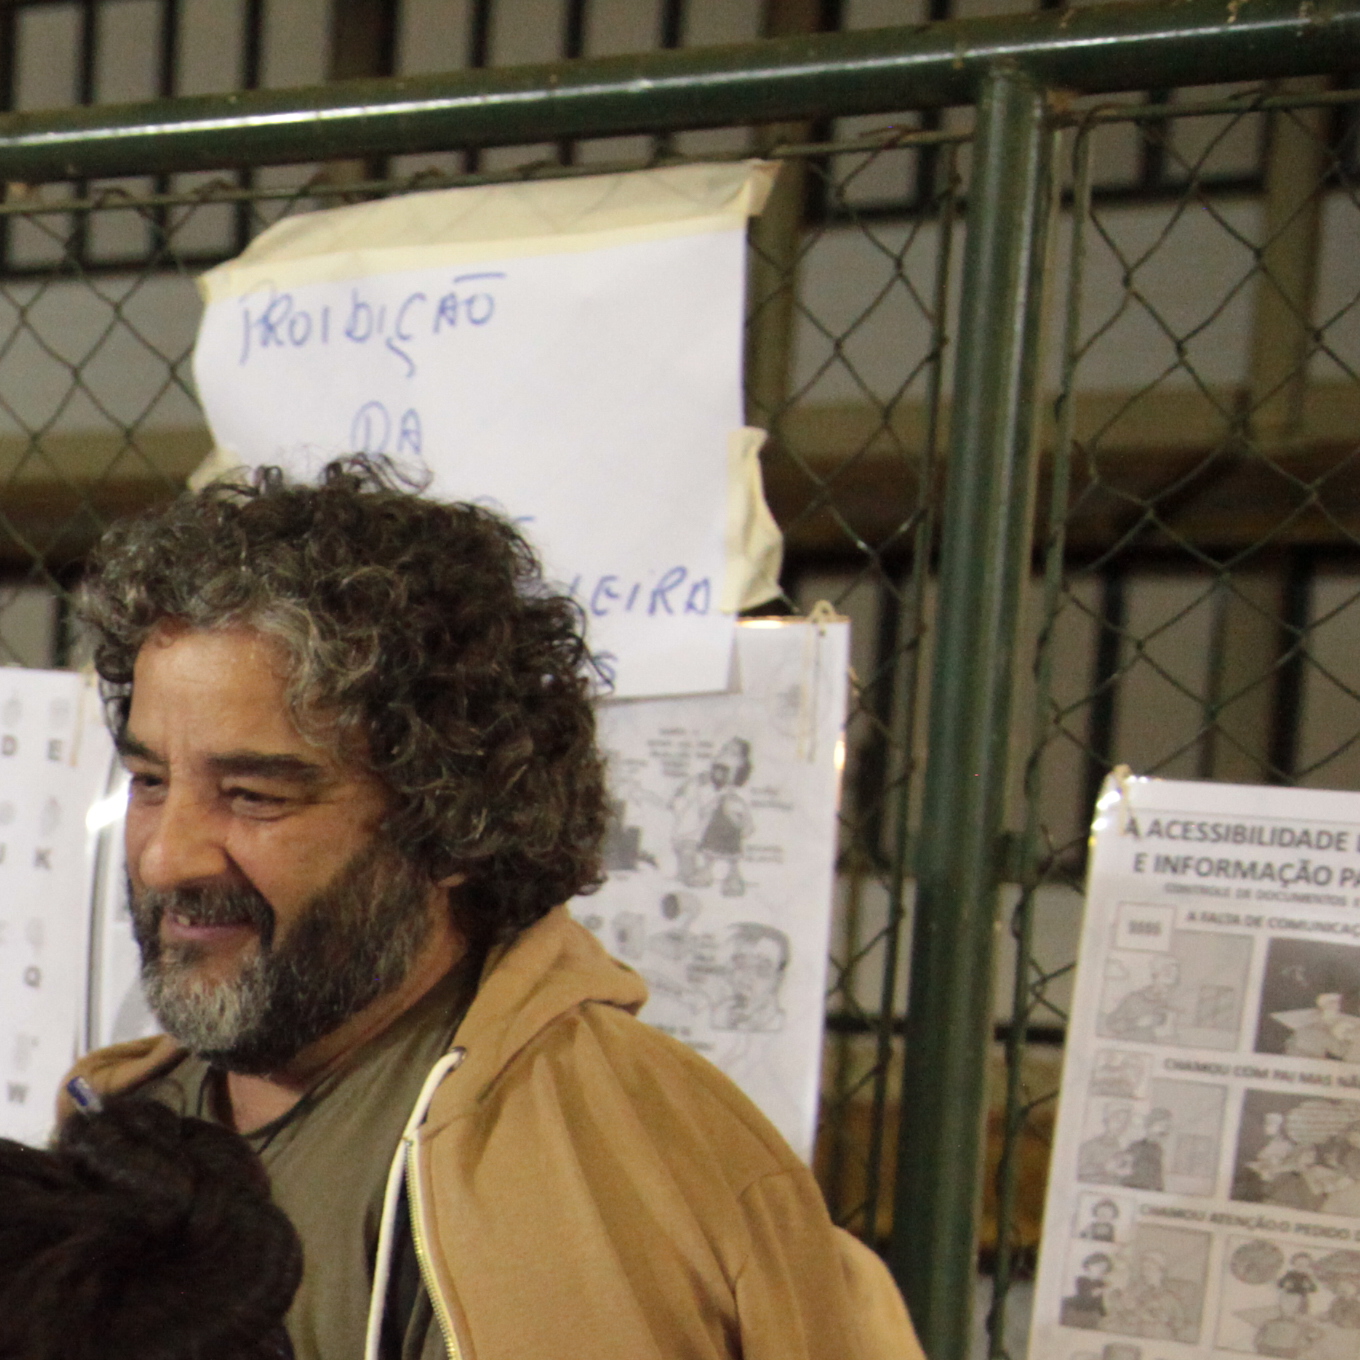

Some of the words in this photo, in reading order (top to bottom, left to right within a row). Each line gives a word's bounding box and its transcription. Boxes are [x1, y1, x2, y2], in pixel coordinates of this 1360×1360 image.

[349, 399, 423, 459] DA
[569, 564, 713, 617] EIRA
[0, 734, 18, 757] D
[46, 738, 64, 762] E
[1124, 817, 1142, 842] A
[1148, 818, 1347, 852] ACESSIBILIDADE
[33, 847, 52, 870] K
[1132, 852, 1145, 873] E
[1153, 852, 1332, 889] INFORMAÇÃO
[23, 965, 43, 989] Q
[6, 1081, 30, 1105] W
